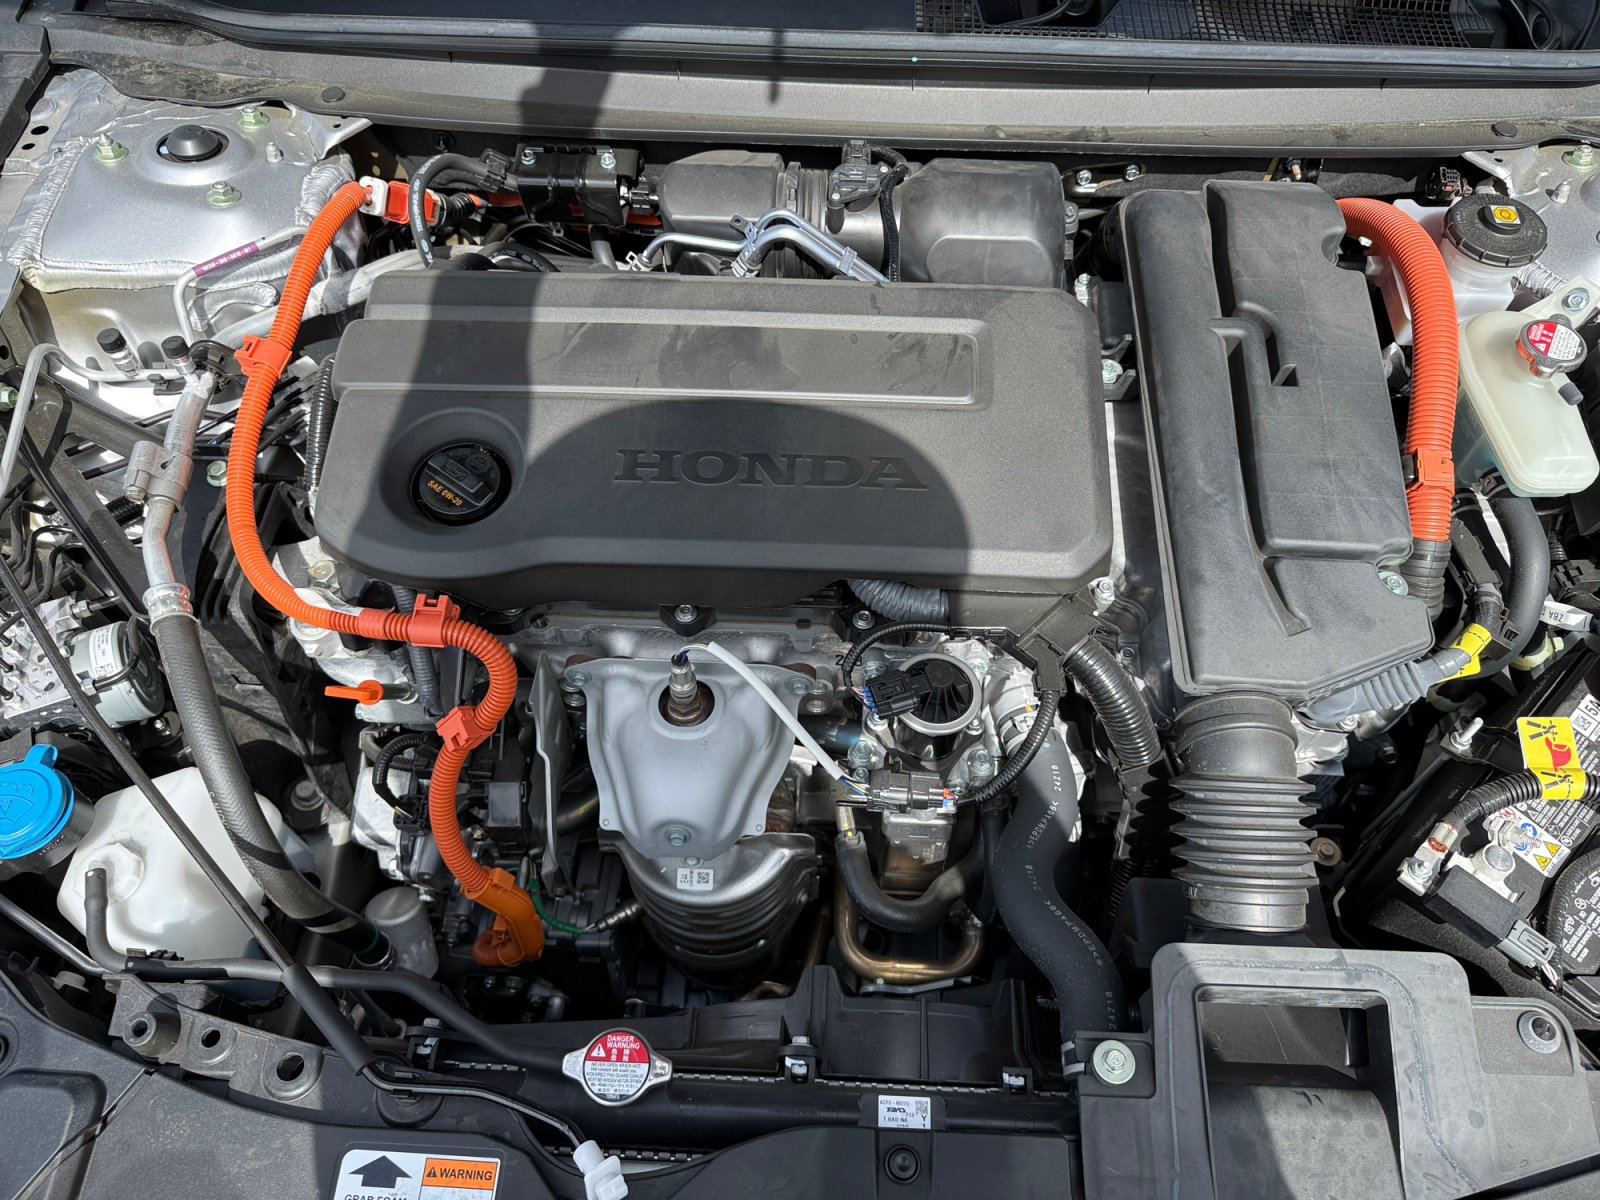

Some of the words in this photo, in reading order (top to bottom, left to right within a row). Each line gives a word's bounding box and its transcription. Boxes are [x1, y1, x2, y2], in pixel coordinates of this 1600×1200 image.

[613, 449, 928, 491] HONDA
[427, 480, 444, 493] SAE
[441, 488, 463, 506] 0W-20
[607, 1040, 640, 1049] WARNUNG
[440, 1168, 492, 1181] WARNING
